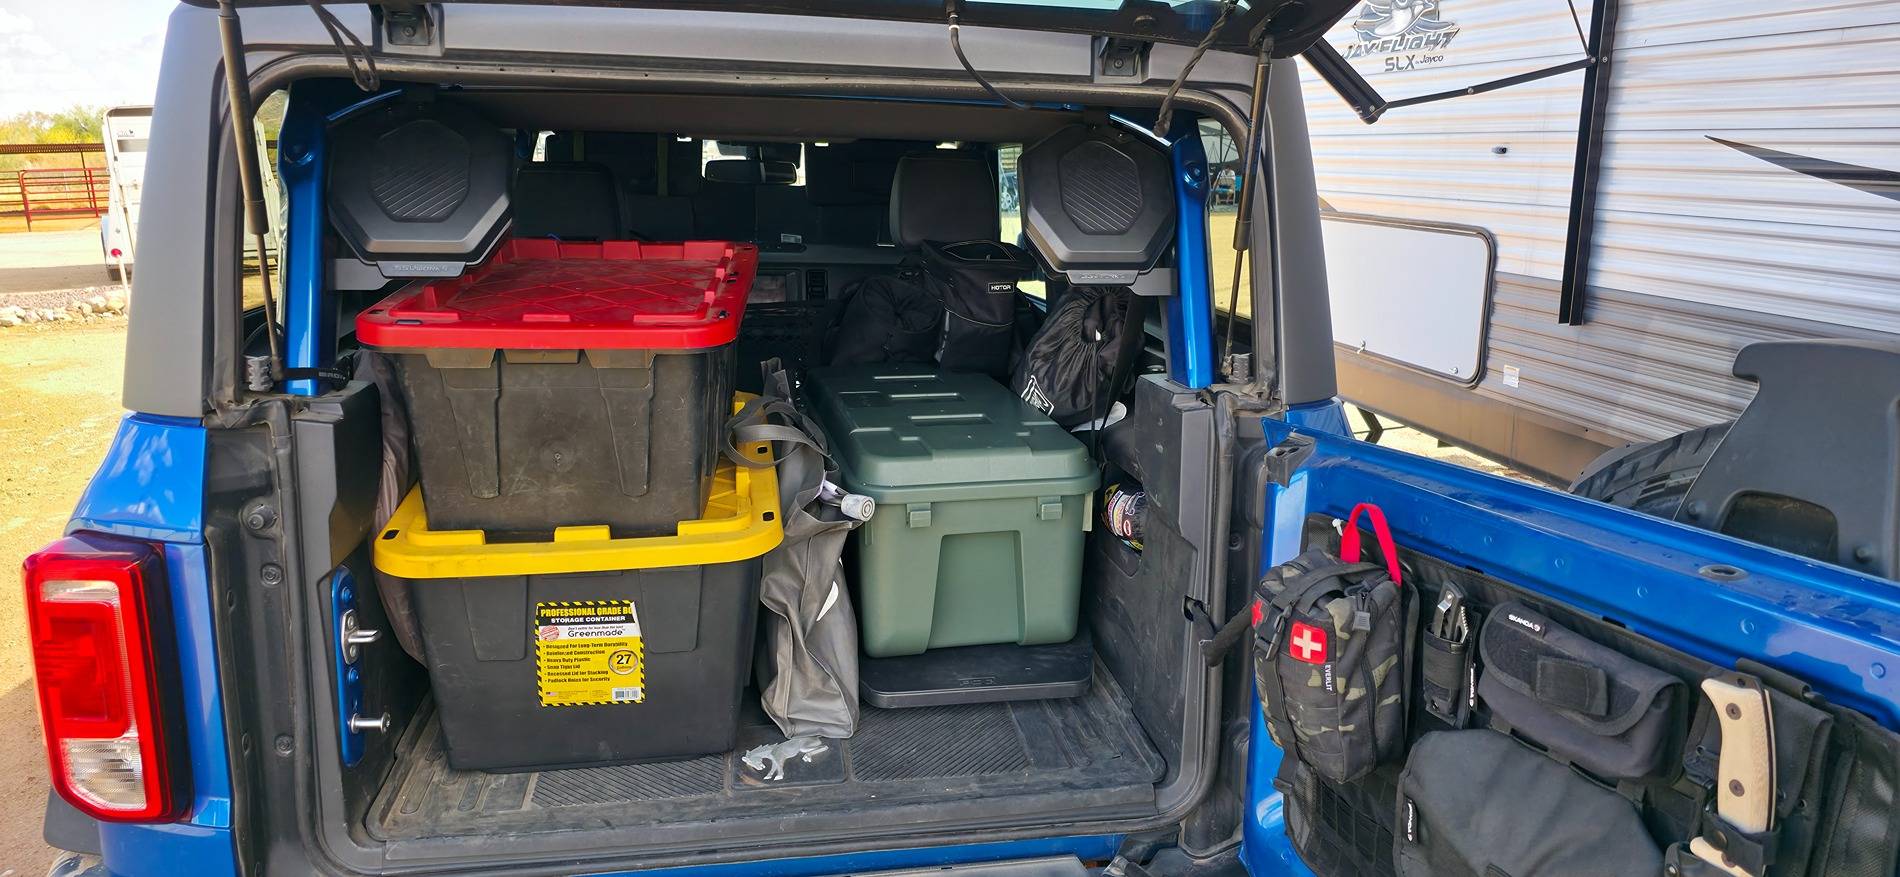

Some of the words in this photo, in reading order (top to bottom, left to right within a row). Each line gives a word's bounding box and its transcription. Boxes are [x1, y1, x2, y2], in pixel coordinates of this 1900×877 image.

[1384, 54, 1416, 72] SLX
[1419, 54, 1444, 64] Jayco
[540, 607, 597, 617] PROFESSIONAL
[597, 606, 622, 616] GRADE
[585, 615, 626, 623] CONTAINER
[567, 629, 623, 638] Greenmade
[616, 654, 632, 665] 27
